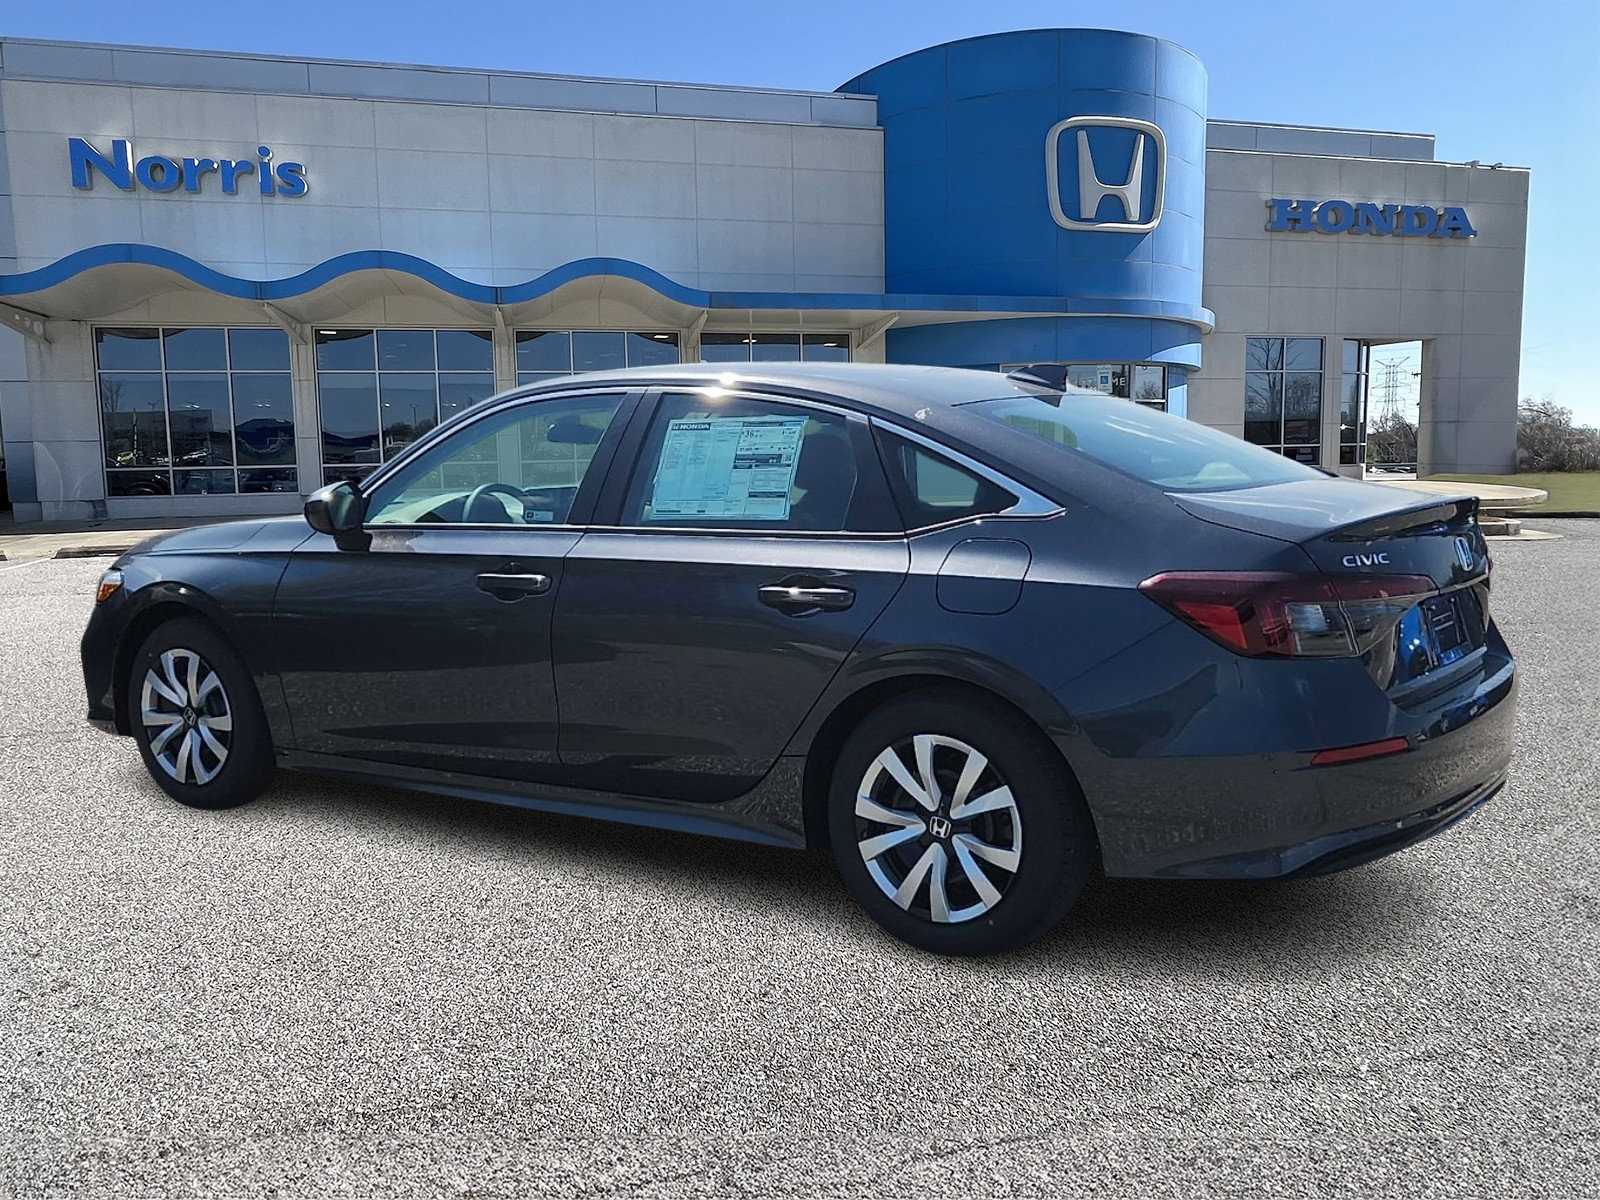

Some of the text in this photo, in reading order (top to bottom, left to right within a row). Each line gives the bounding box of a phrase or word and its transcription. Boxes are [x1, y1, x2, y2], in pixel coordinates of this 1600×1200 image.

[68, 137, 309, 197] Norris
[1265, 198, 1478, 239] HONDA
[1342, 552, 1390, 567] CIVIC
